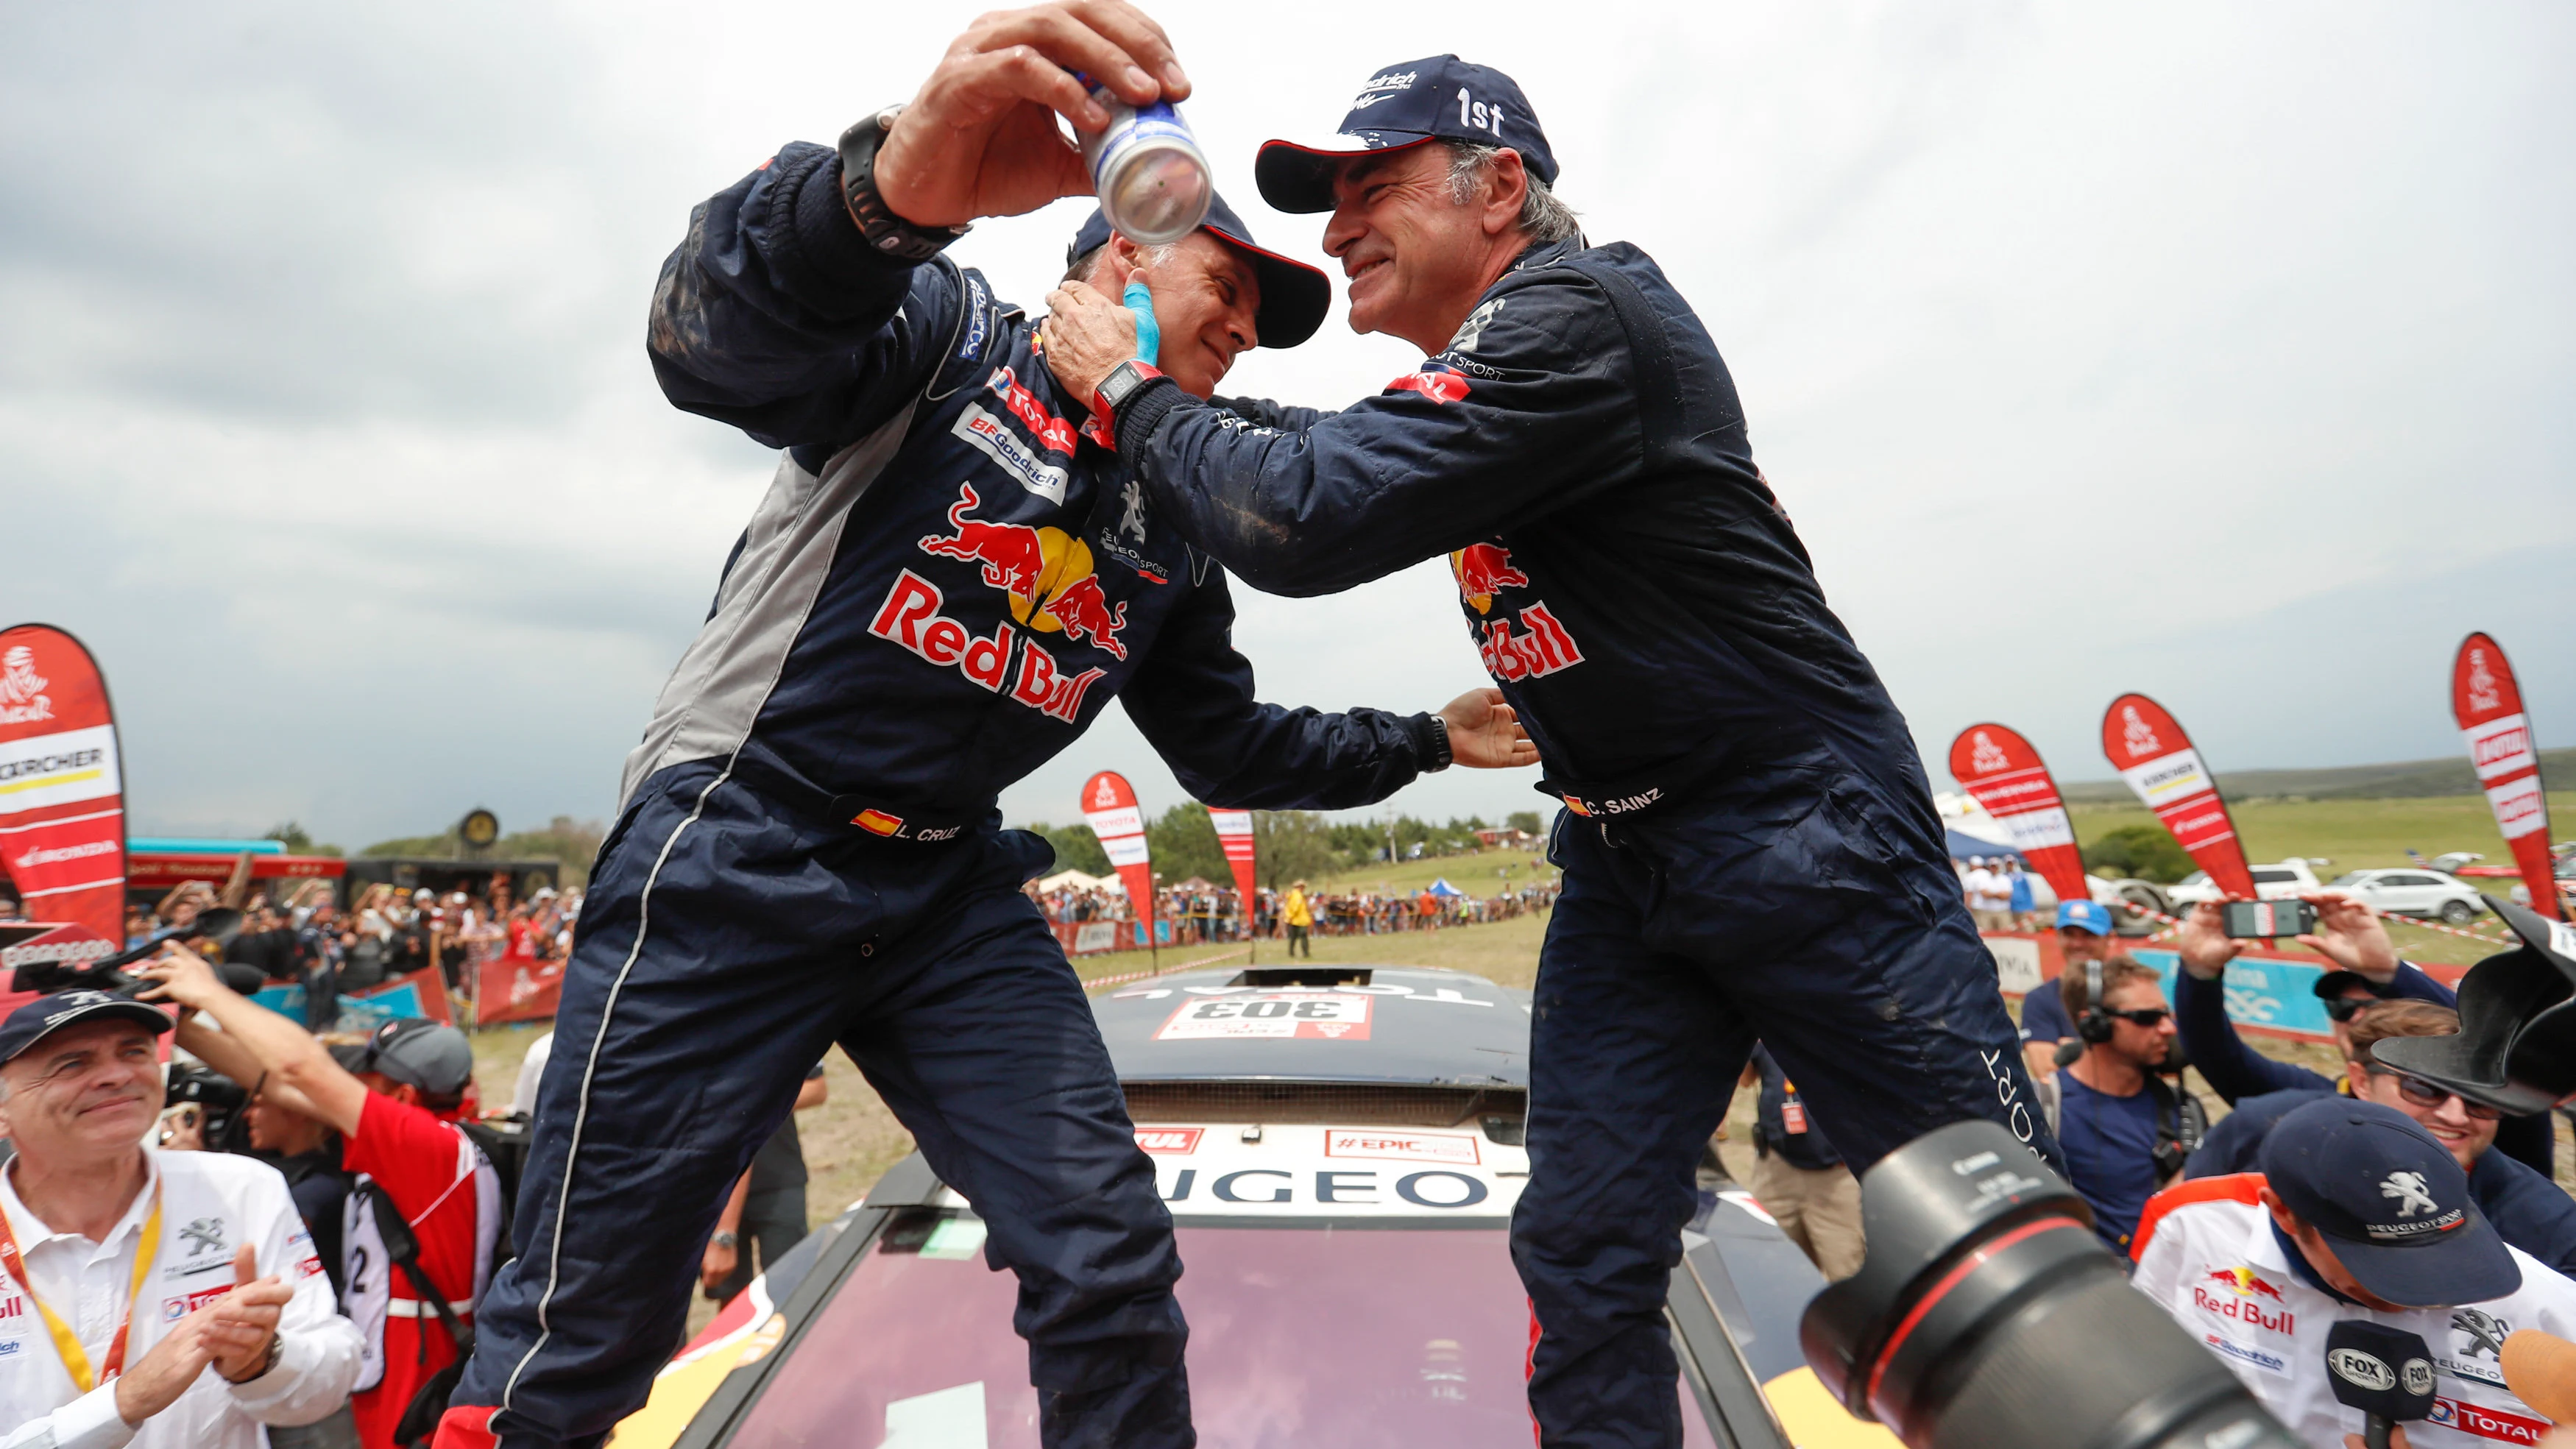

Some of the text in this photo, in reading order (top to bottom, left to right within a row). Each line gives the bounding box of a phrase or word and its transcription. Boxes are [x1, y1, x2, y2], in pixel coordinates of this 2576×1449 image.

[1457, 87, 1505, 138] 1st
[1457, 357, 1506, 382] SPORT
[1013, 387, 1072, 448] TOTAL
[967, 417, 1061, 489] BFGoodrich
[1139, 559, 1168, 578] SPORT
[871, 570, 1104, 723] Red Bull
[1491, 606, 1581, 680] Bull
[1585, 787, 1665, 815] C. SAINZ
[894, 824, 961, 841] L. CRUZ
[1095, 816, 1136, 829] TOYOTA
[1192, 1001, 1341, 1020] 303
[1980, 1049, 2053, 1170] ORT
[1163, 1169, 1529, 1208] UGEO
[2365, 1219, 2438, 1233] PEUGEOT
[2193, 1287, 2295, 1336] Red Bull
[2343, 1354, 2381, 1379] FOX
[2409, 1366, 2429, 1384] FOX
[2433, 1358, 2502, 1380] EUGEO
[2458, 1408, 2545, 1442] TOTAL
